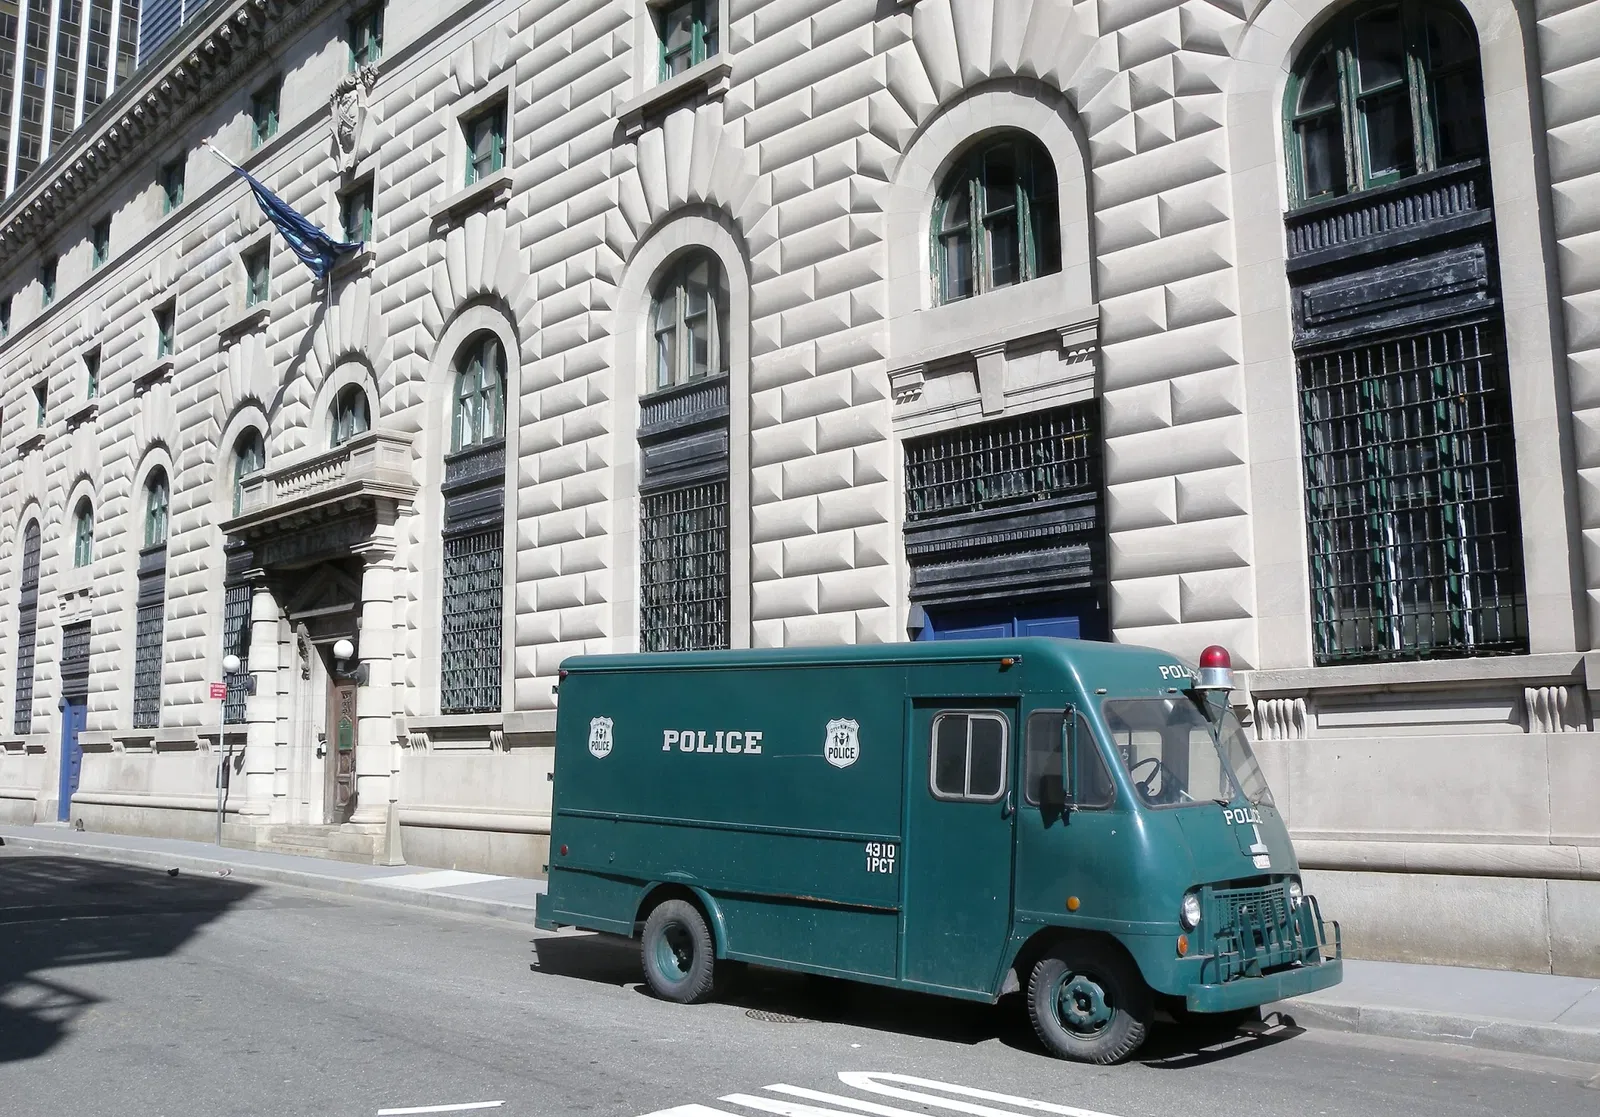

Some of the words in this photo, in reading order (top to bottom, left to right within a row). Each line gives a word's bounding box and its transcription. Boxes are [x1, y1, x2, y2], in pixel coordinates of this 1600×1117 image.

[591, 740, 610, 751] POLICE
[662, 729, 763, 754] POLICE
[828, 747, 855, 759] POLICE
[865, 842, 895, 858] 4310
[866, 857, 895, 874] 1PCT
